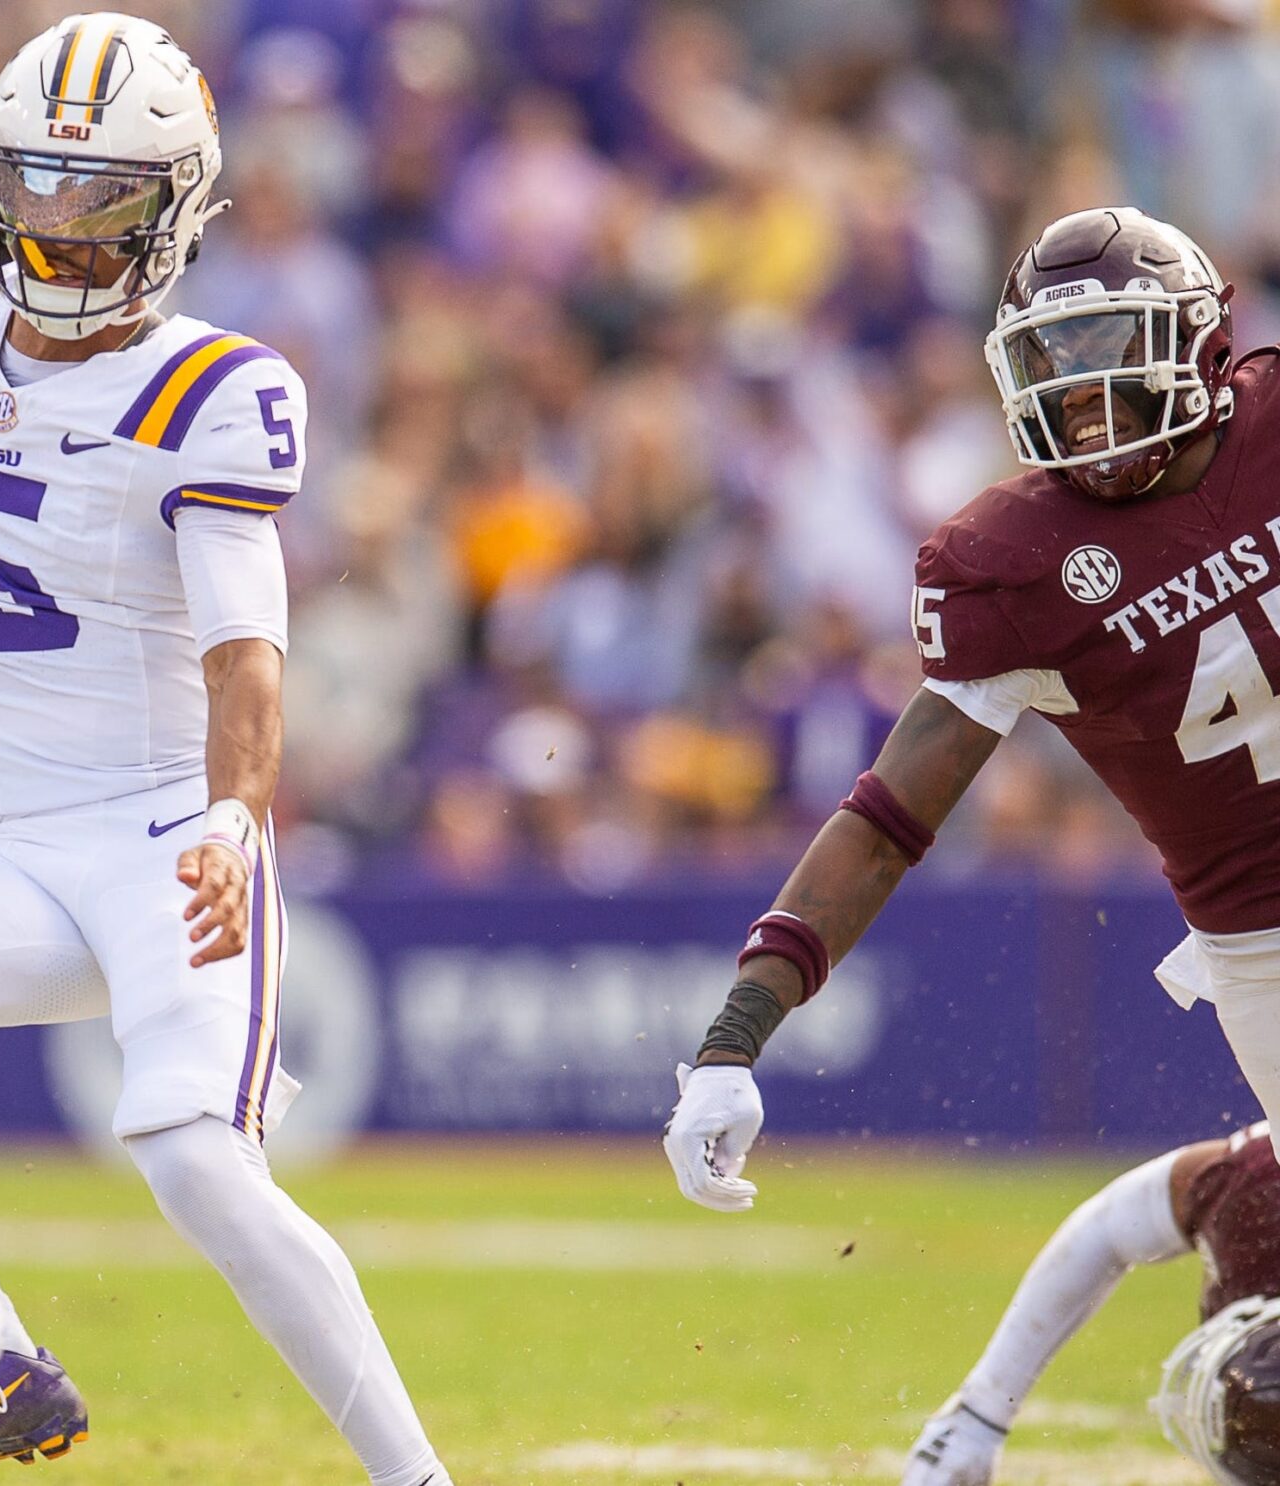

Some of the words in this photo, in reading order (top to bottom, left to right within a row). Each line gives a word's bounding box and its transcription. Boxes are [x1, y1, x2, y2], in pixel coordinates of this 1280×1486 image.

[48, 123, 90, 141] LSU
[1045, 284, 1085, 302] AGGIES
[256, 386, 297, 469] 5
[1065, 548, 1117, 600] SEC
[1102, 534, 1269, 653] TEXAS
[911, 585, 946, 659] 5
[1174, 585, 1280, 784] 4
